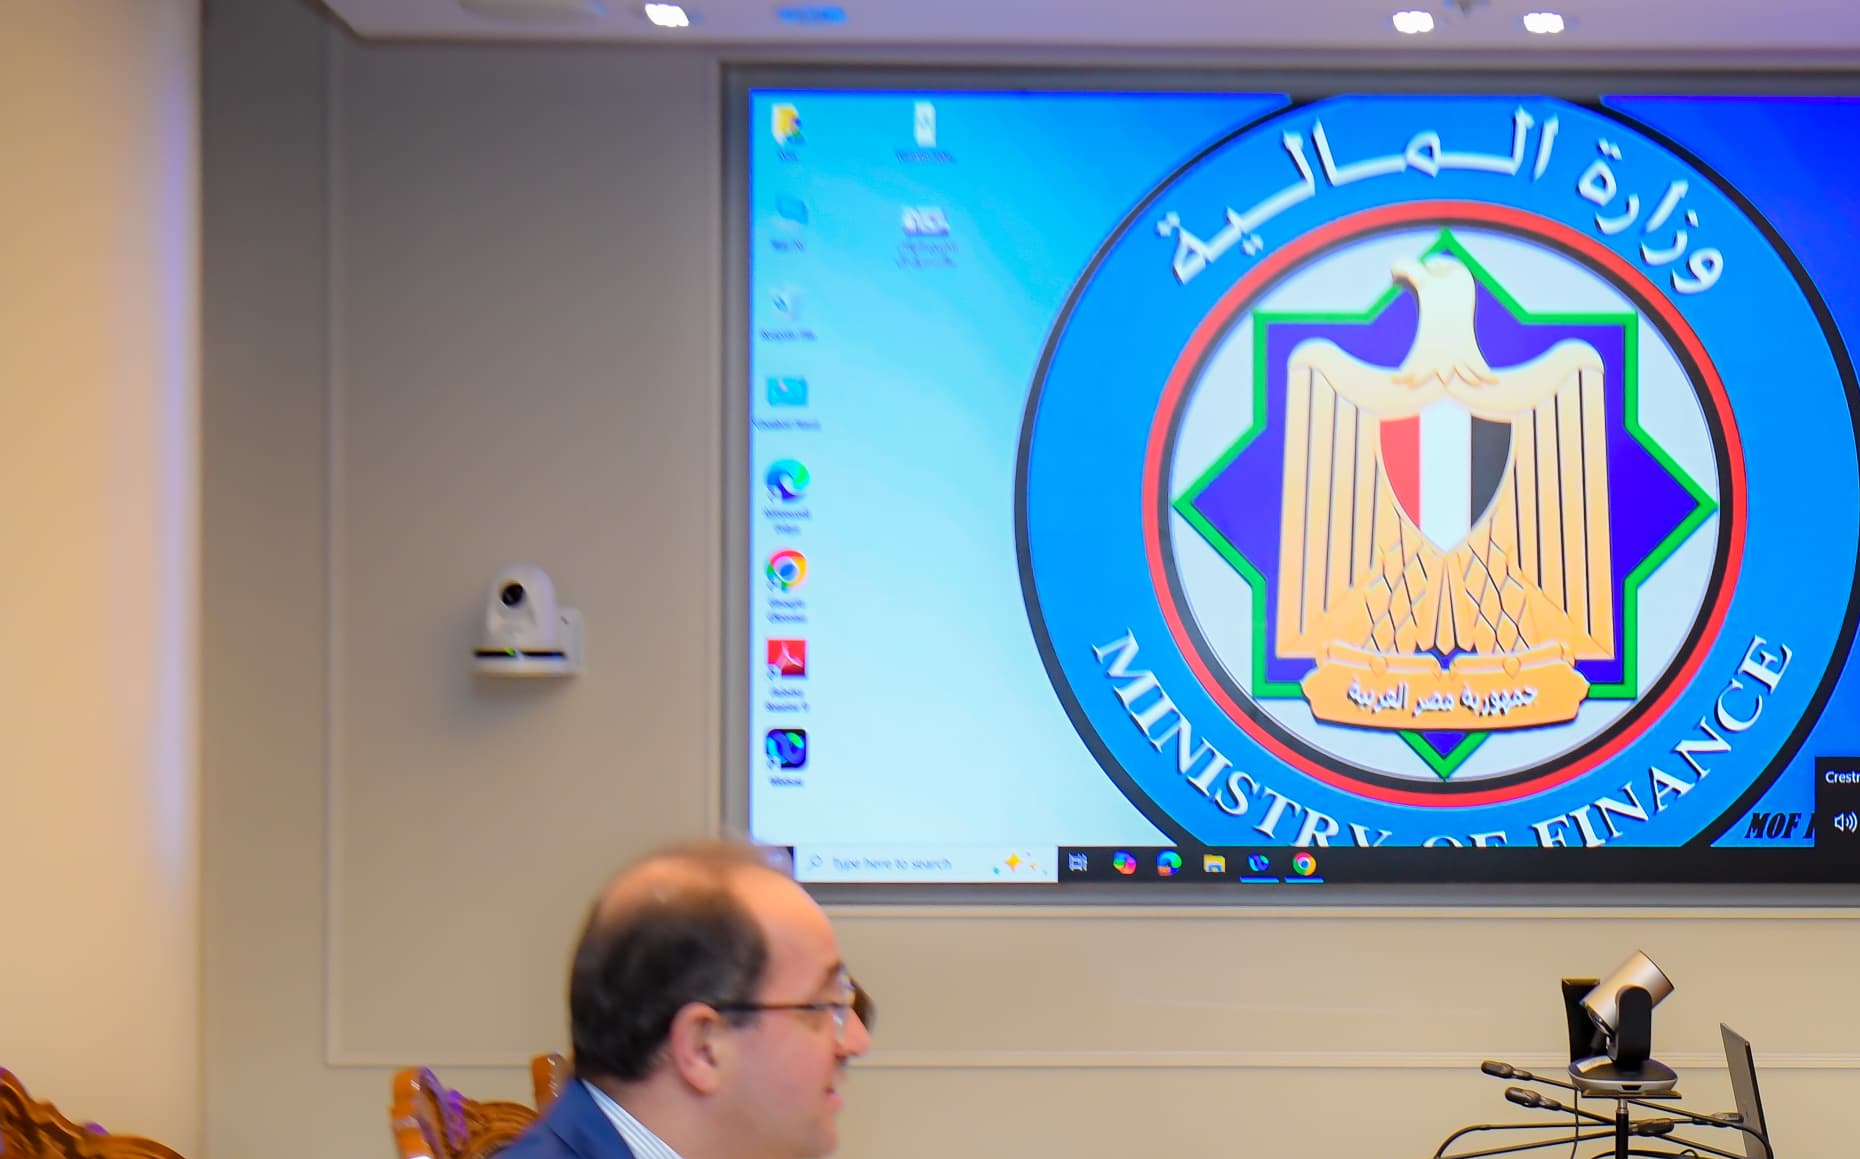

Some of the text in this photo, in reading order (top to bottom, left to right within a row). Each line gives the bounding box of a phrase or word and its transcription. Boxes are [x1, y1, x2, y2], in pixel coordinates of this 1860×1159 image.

[1156, 103, 1724, 295] وزارة المالية
[1346, 675, 1538, 718] جمهورية مصر العربية
[1530, 633, 1794, 848] FINANCE
[1745, 812, 1801, 839] MOF
